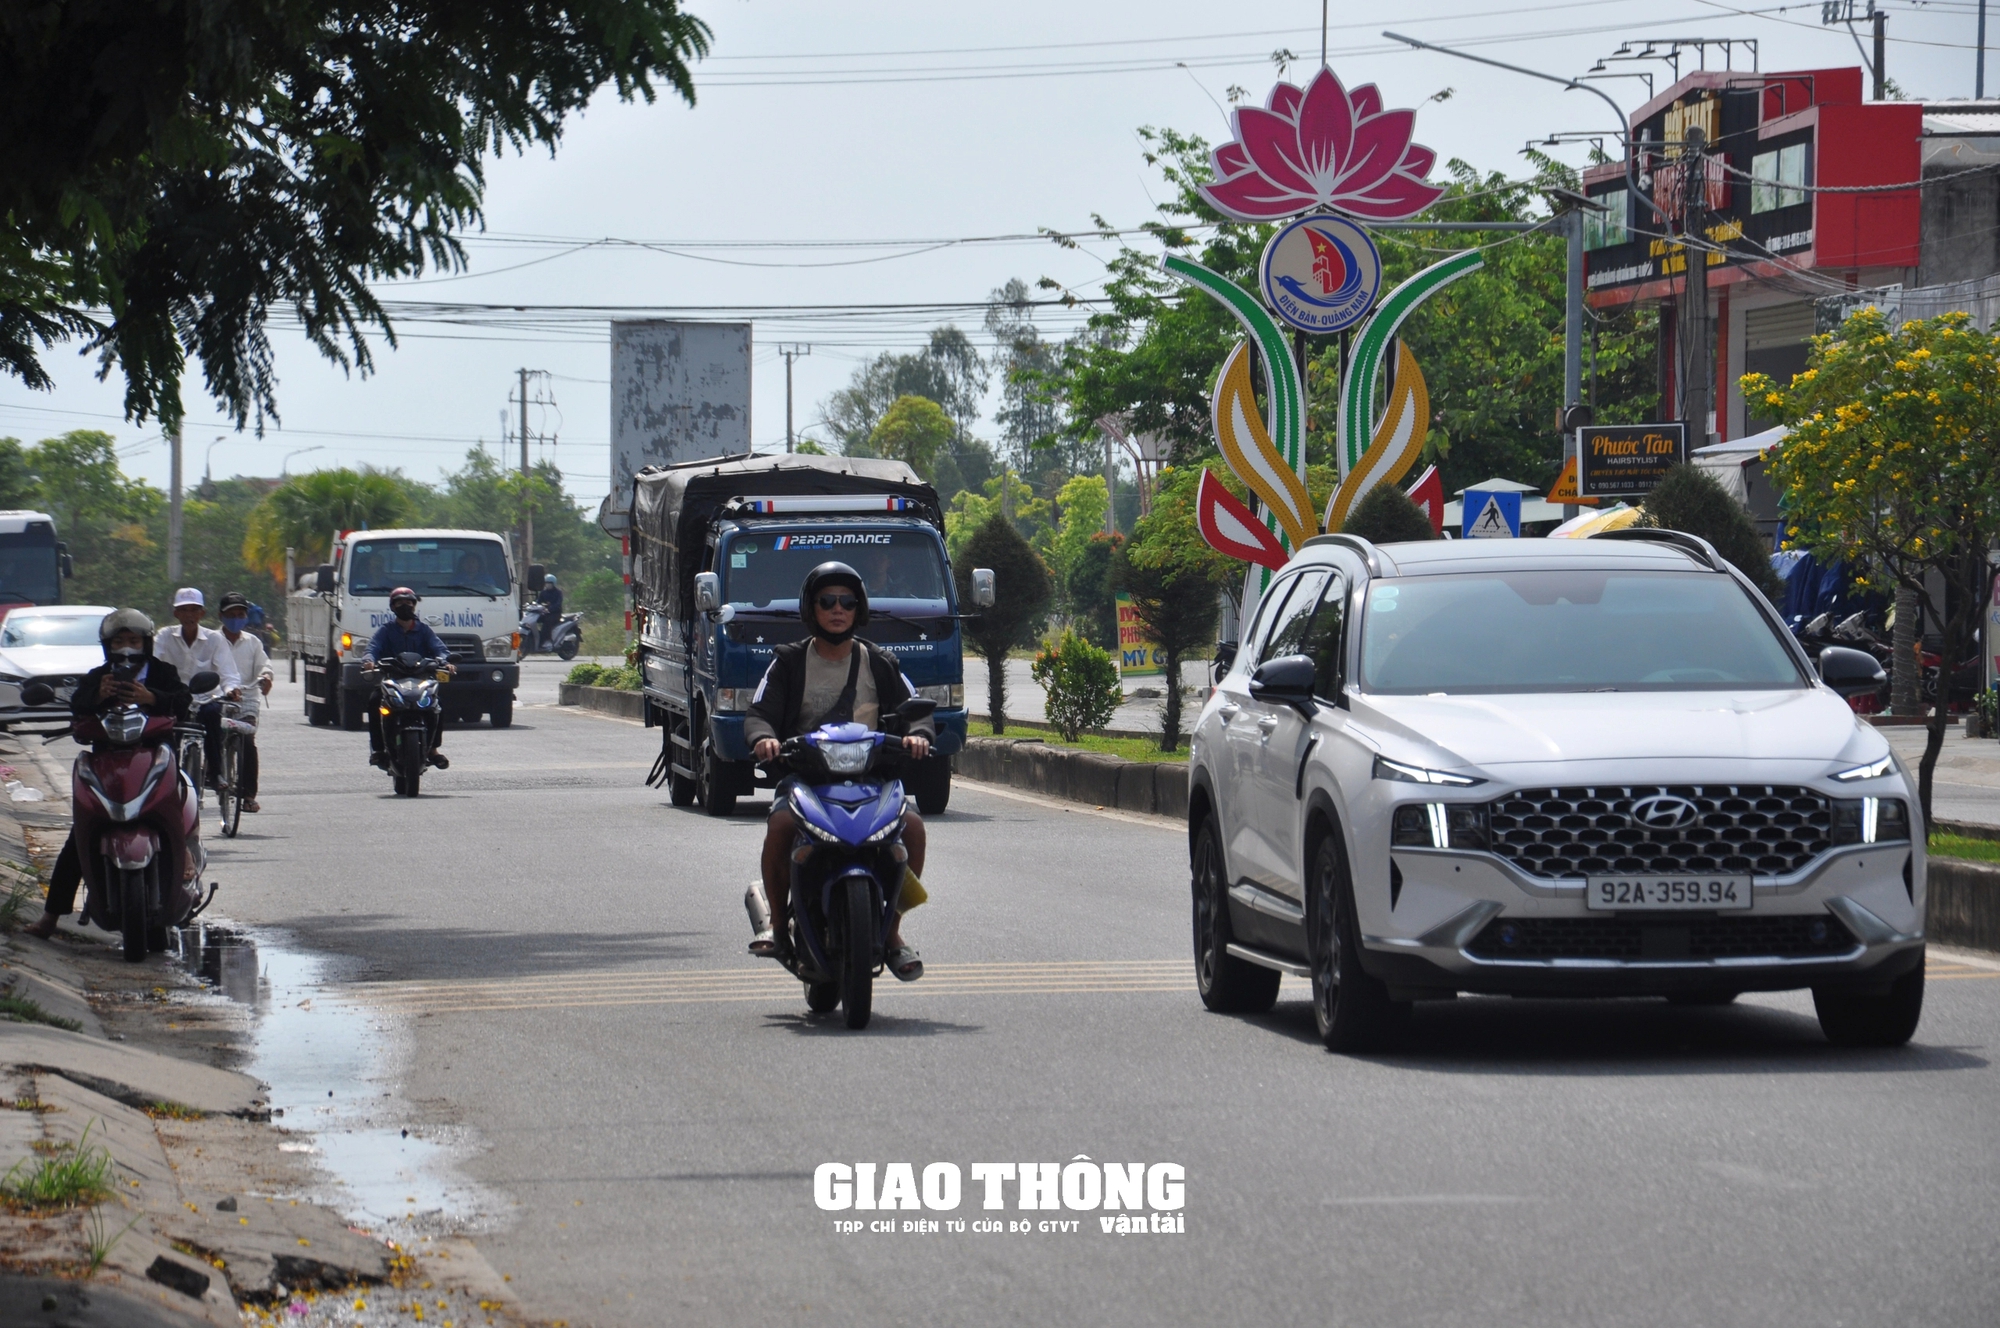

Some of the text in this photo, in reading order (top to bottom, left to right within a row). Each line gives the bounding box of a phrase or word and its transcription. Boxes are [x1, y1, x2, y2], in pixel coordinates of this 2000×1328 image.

[1279, 294, 1298, 314] ĐIỆN
[1321, 307, 1353, 325] QUẢNG
[1350, 290, 1369, 312] NAM
[1591, 433, 1674, 456] Phước Tân
[1607, 456, 1658, 465] HAIRSTYLIST
[790, 534, 892, 545] PERFORMANCE
[443, 610, 457, 628] ĐÀ
[458, 607, 484, 628] NẴNG
[881, 644, 933, 652] FRONTIER
[1601, 881, 1738, 904] 92A-359.94
